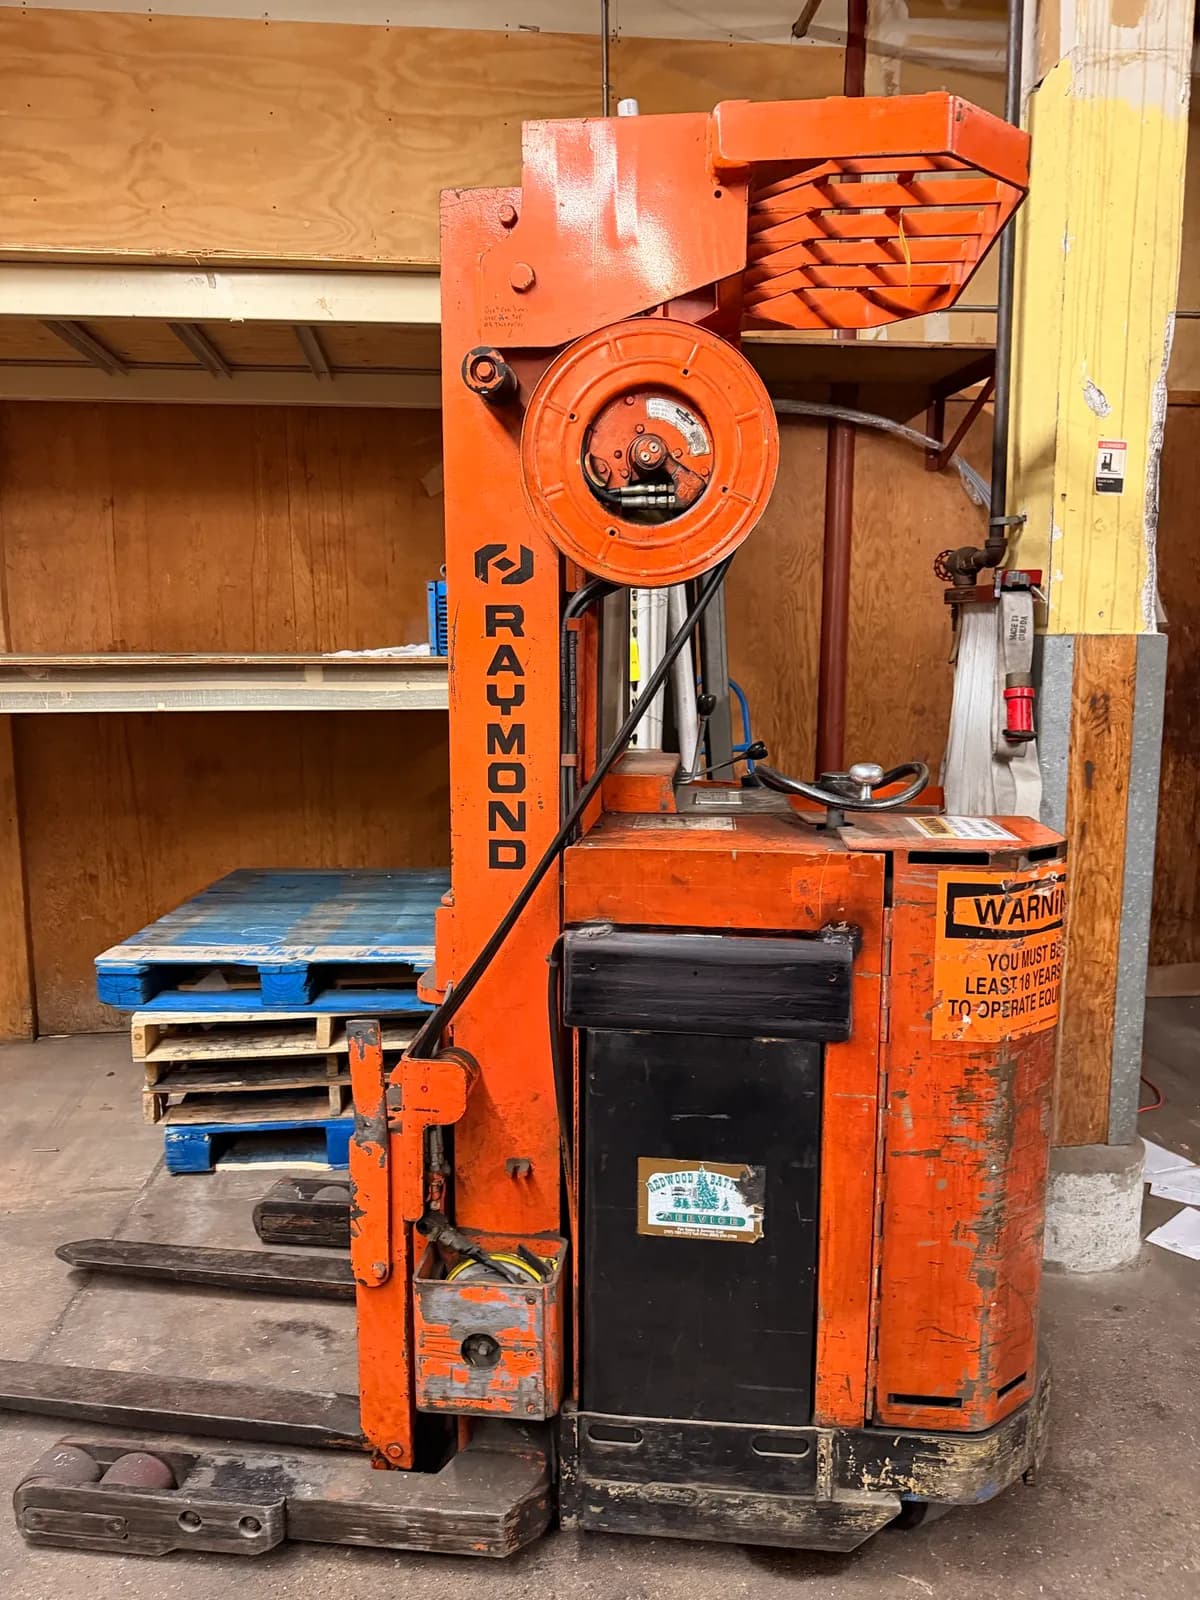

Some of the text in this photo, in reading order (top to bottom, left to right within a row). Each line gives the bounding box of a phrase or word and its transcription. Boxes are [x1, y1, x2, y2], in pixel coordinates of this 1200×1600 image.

[485, 604, 526, 870] RAYMOND
[988, 952, 1019, 971] YOU
[1021, 945, 1048, 968] MUST
[965, 976, 1018, 995] LEAST
[1020, 973, 1031, 991] 18
[948, 1000, 972, 1017] TO
[977, 993, 1036, 1019] OPERATE
[647, 1172, 694, 1193] REDWOOD
